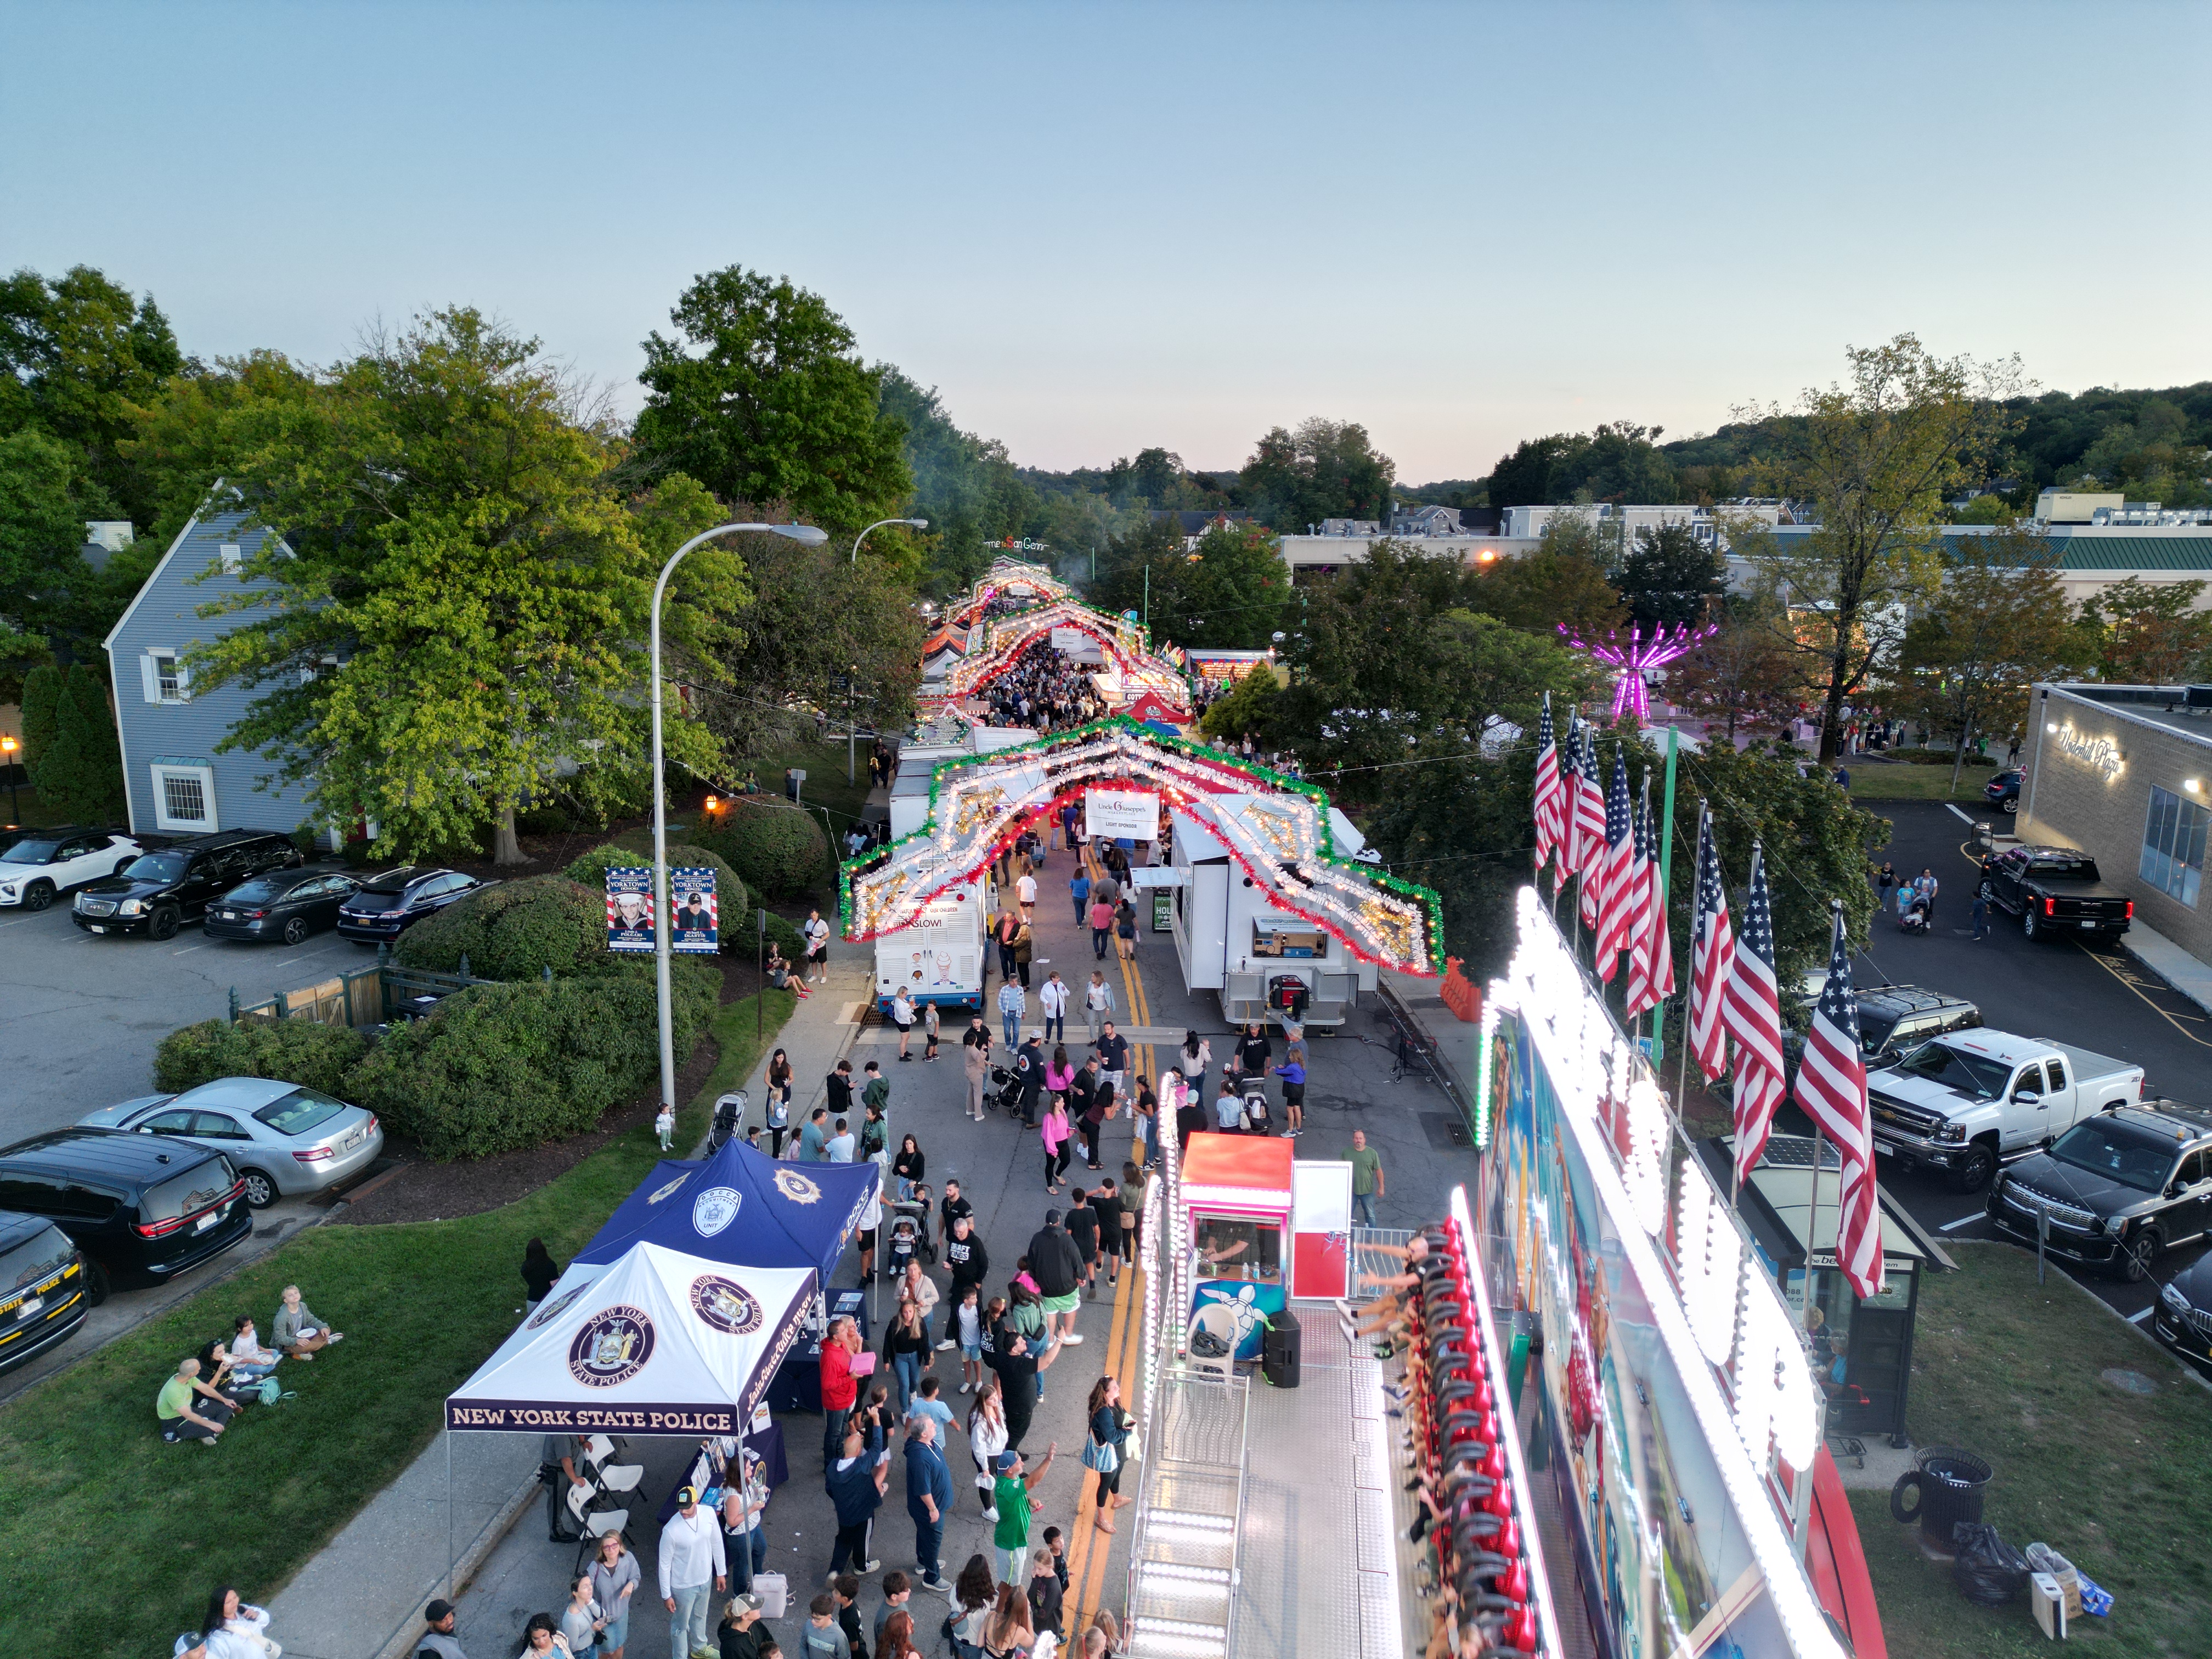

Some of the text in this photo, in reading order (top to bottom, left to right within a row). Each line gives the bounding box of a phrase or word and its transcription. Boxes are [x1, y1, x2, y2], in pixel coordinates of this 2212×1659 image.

[1006, 536, 1022, 549] San
[2058, 725, 2120, 781] Underhill Plaza
[1113, 800, 1146, 813] Giuseppe's
[914, 919, 942, 928] SLOW!
[2100, 957, 2143, 982] FIRE LANE
[701, 1190, 738, 1200] DOCCS
[698, 1198, 736, 1208] RECRUITMENT
[847, 1185, 870, 1227] DOCCS
[950, 1242, 970, 1252] DRAFT
[950, 1249, 969, 1260] KINGS
[1821, 1256, 1837, 1265] be
[36, 1276, 61, 1296] POLICE
[691, 1276, 718, 1309] NEW YORK
[590, 1307, 650, 1328] NEW YORK
[729, 1324, 758, 1335] STATE
[570, 1360, 643, 1386] STATE POLICE
[453, 1408, 731, 1431] NEW YORK STATE POLICE
